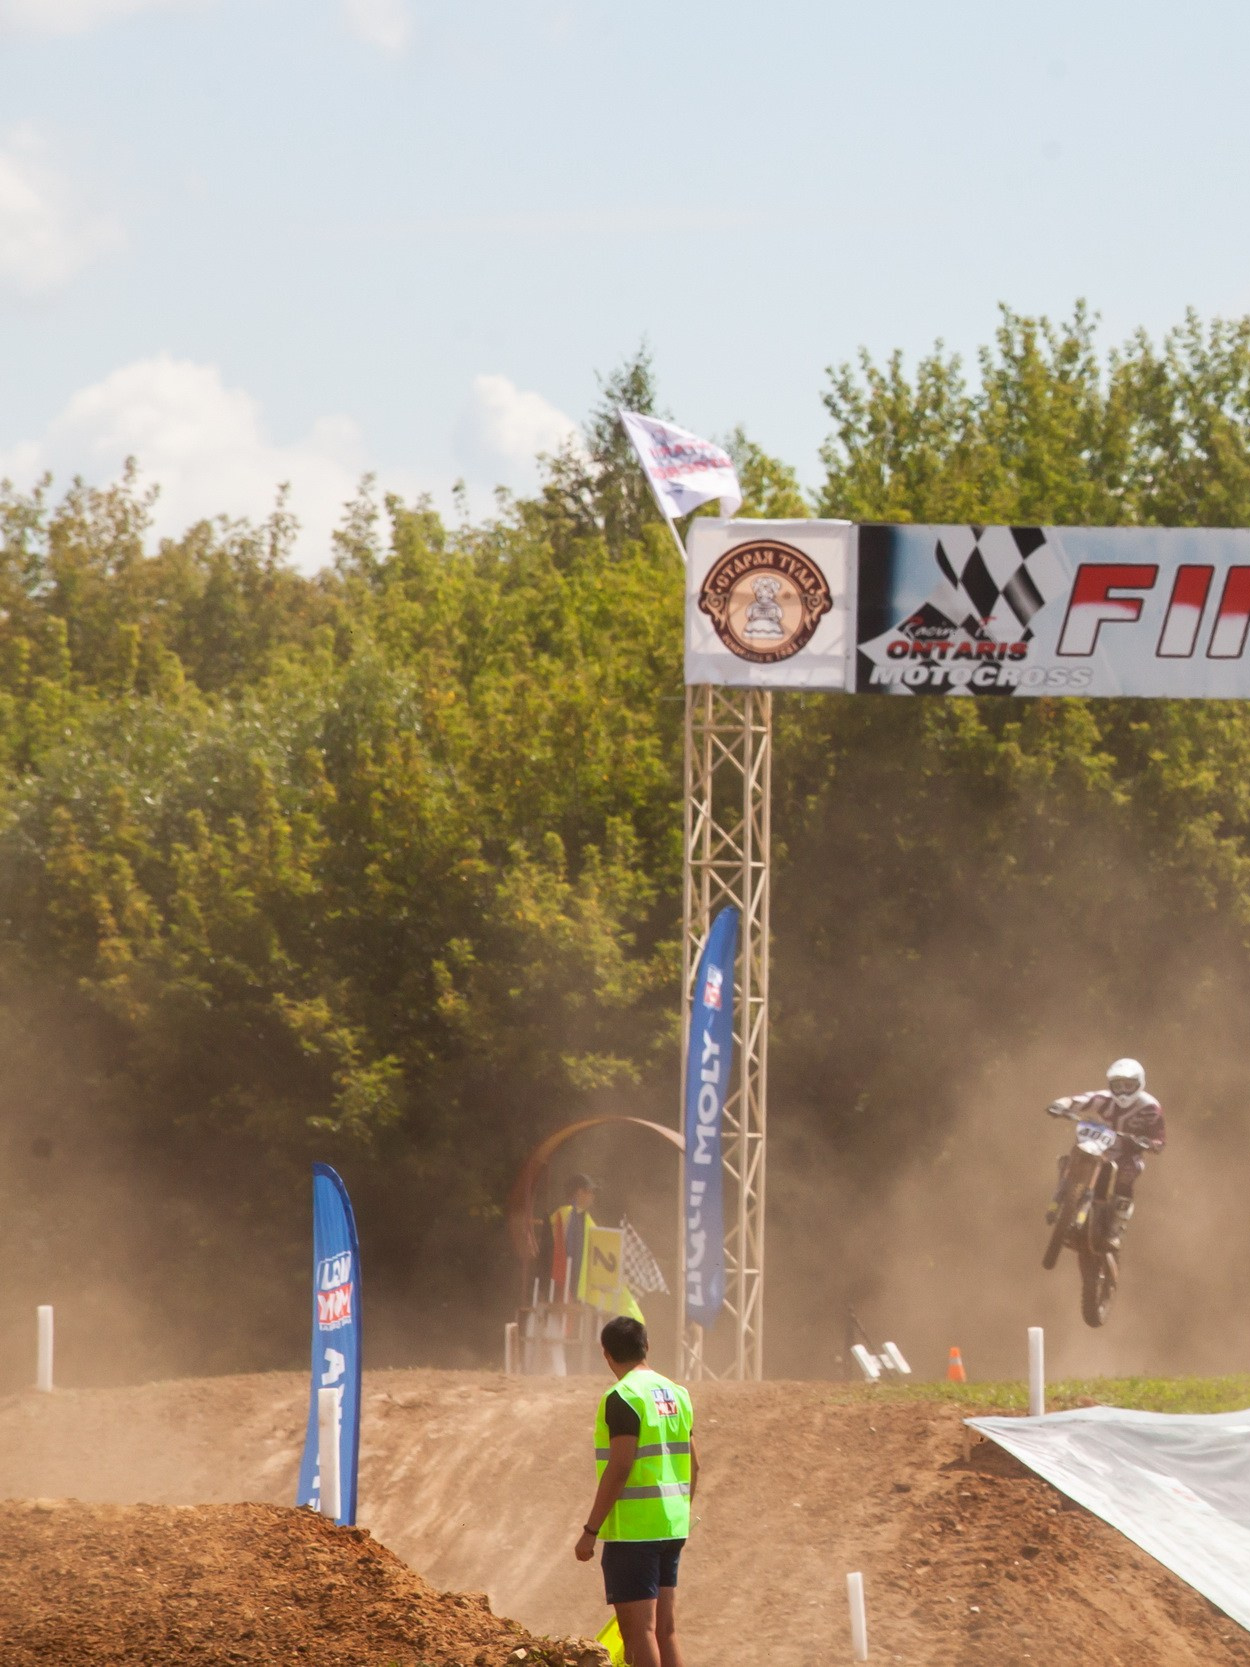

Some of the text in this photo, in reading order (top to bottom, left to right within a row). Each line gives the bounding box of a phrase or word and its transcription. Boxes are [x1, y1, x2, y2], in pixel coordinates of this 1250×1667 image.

[886, 639, 1029, 662] ONTARIS
[868, 664, 1094, 689] MOTOCROSS
[693, 1029, 720, 1165] MOLY
